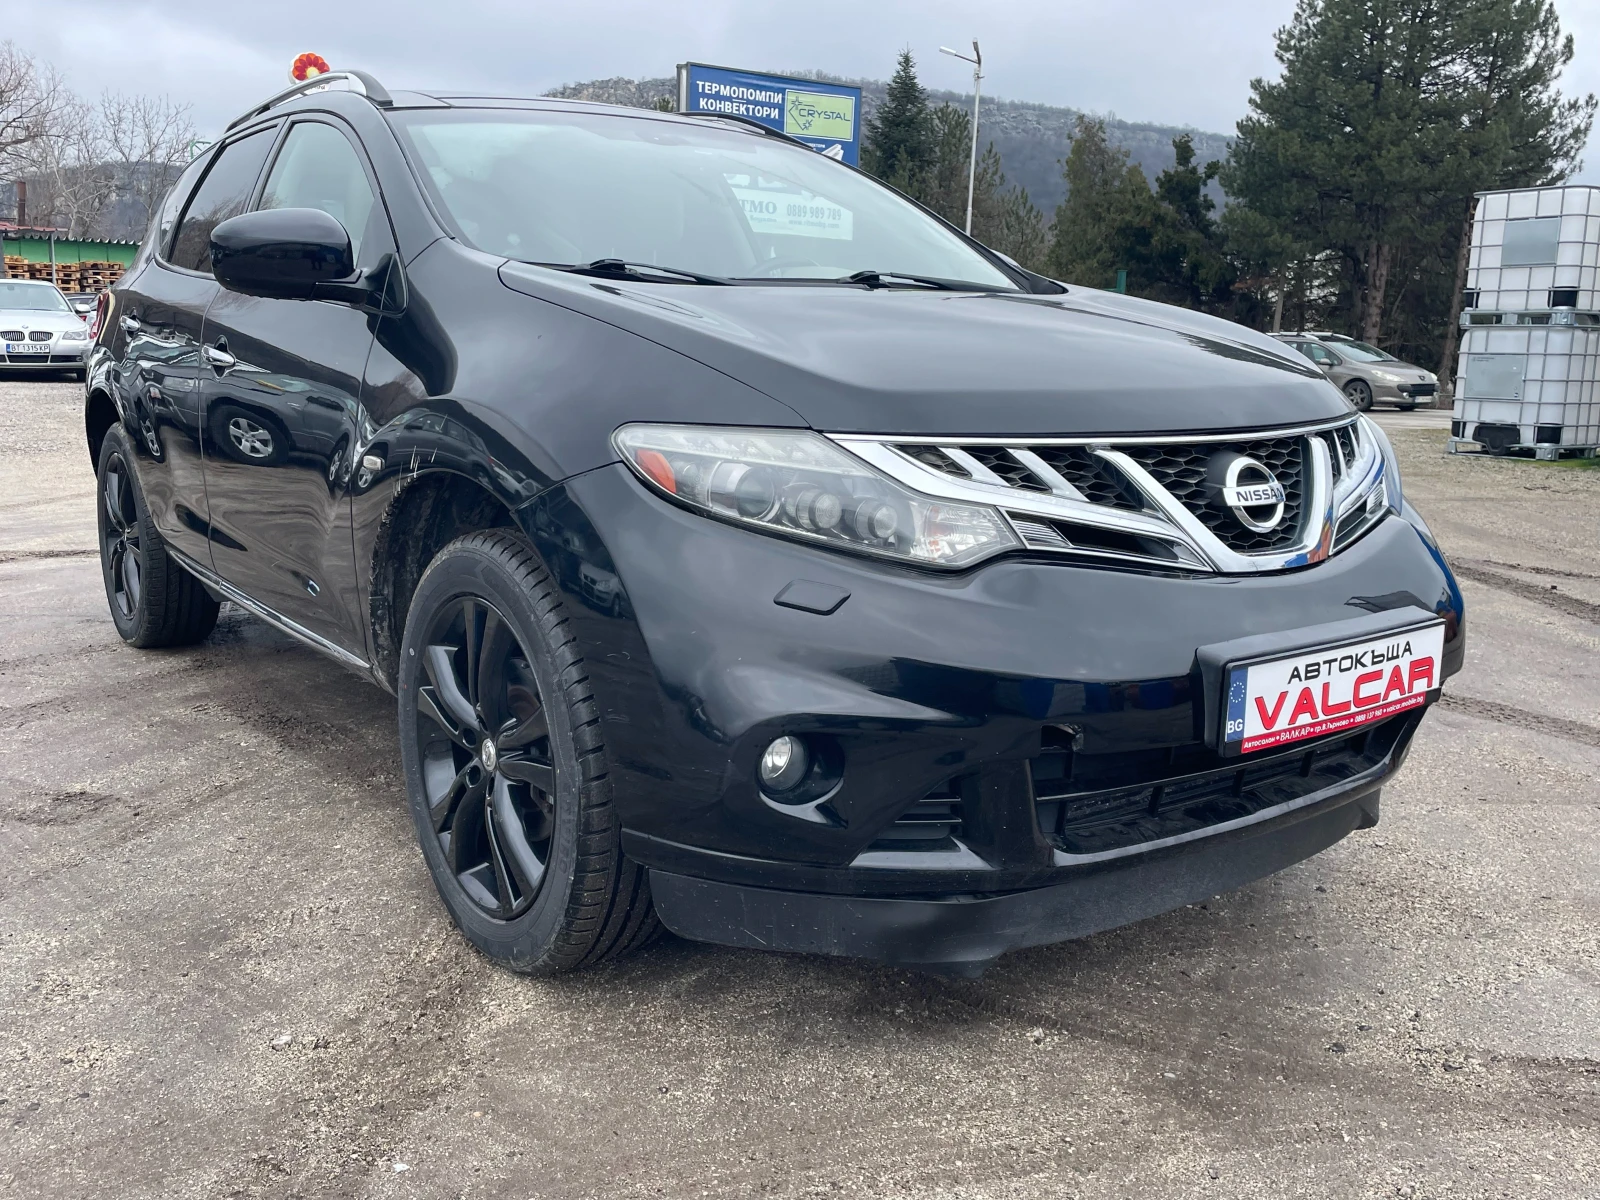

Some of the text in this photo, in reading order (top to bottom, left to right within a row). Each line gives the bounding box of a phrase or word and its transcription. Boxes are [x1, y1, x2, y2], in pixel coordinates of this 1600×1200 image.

[696, 80, 783, 104] ТЕРМОПОМПИ
[699, 97, 779, 120] КОНВЕКТОРИ
[799, 108, 851, 122] CRYSTAL
[739, 199, 778, 215] TMO
[786, 203, 808, 218] 0889
[809, 206, 825, 219] 989
[22, 344, 38, 352] 1315
[1235, 488, 1284, 502] NISSAN
[1254, 656, 1435, 731] VALCAR
[1227, 718, 1244, 734] BG
[1243, 736, 1276, 749] Автосалон
[1280, 726, 1310, 741] ВАЛКАР
